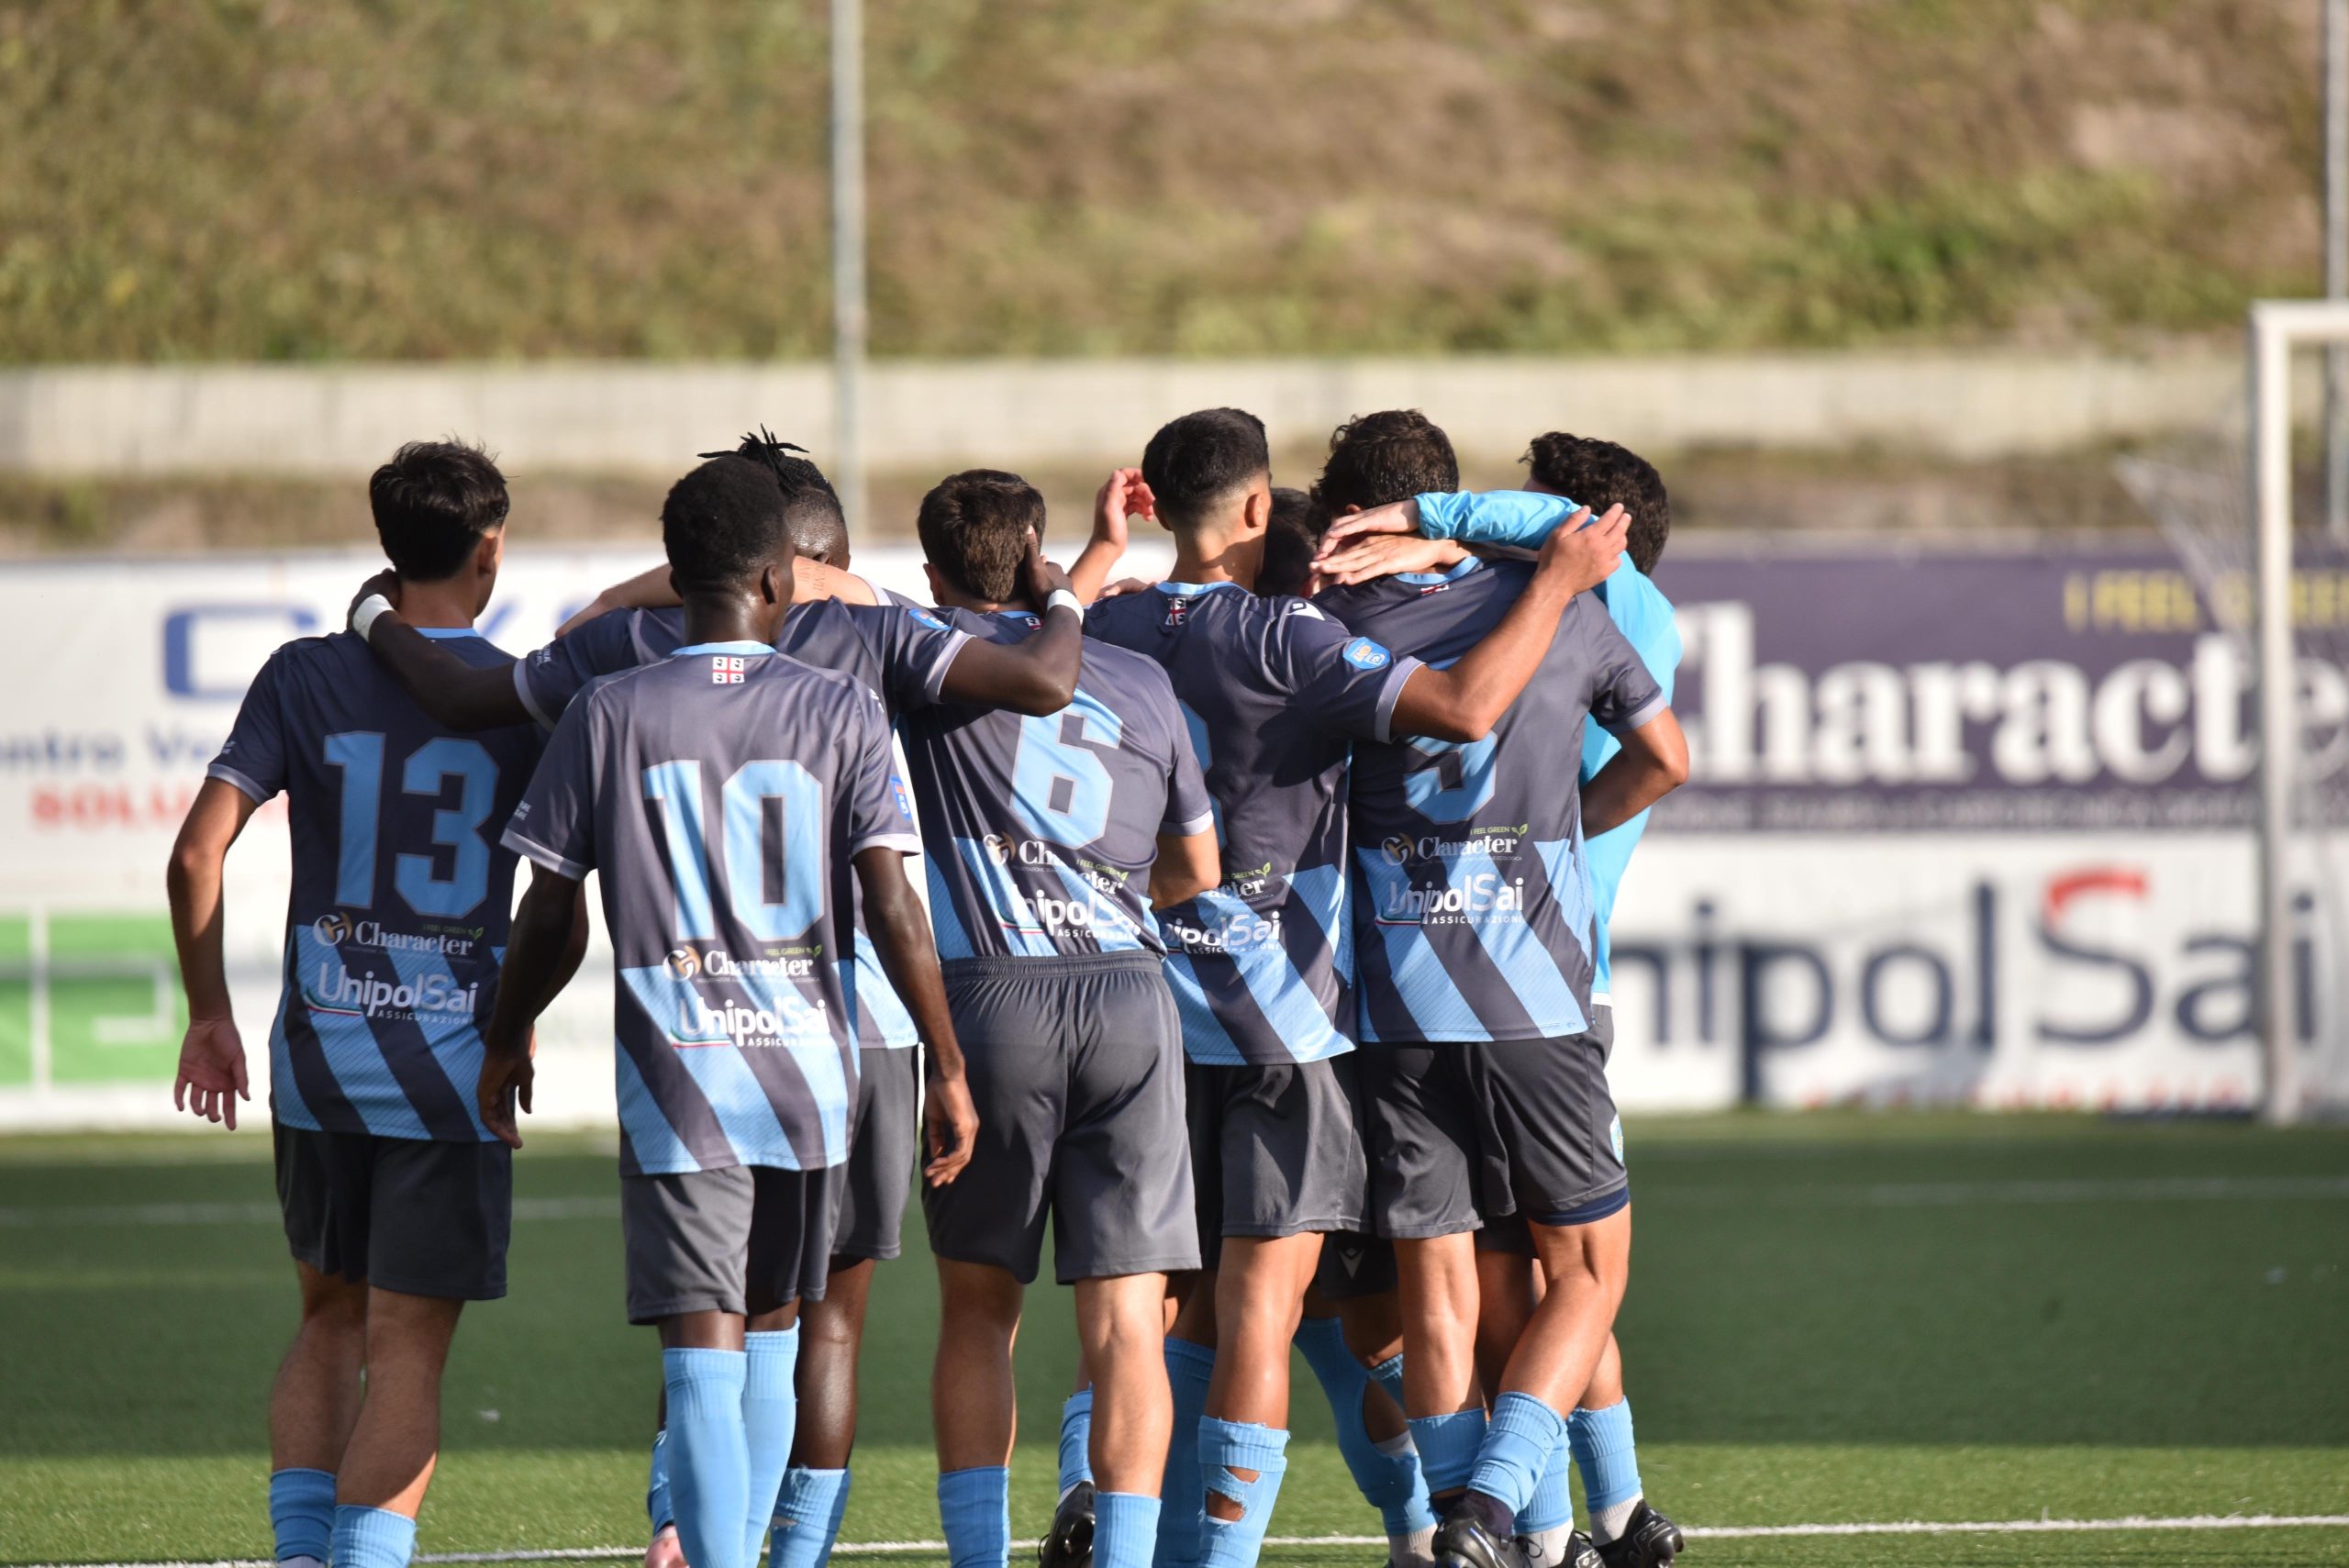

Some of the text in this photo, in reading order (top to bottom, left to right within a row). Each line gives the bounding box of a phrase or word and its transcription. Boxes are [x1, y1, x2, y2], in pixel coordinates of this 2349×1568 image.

[1676, 601, 2349, 785] haracte
[1009, 688, 1124, 851] 6
[323, 730, 500, 918] 13
[643, 759, 825, 942] 10
[1388, 873, 1524, 924] UnipolSai
[1431, 916, 1523, 925] ASSICURZIONI
[354, 920, 473, 956] Character
[704, 949, 814, 976] Character
[318, 962, 479, 1017] UnipolSai
[1610, 861, 2318, 1105] nipolSai
[378, 1009, 474, 1025] ASSICURAZION
[681, 995, 830, 1047] UnipolSai
